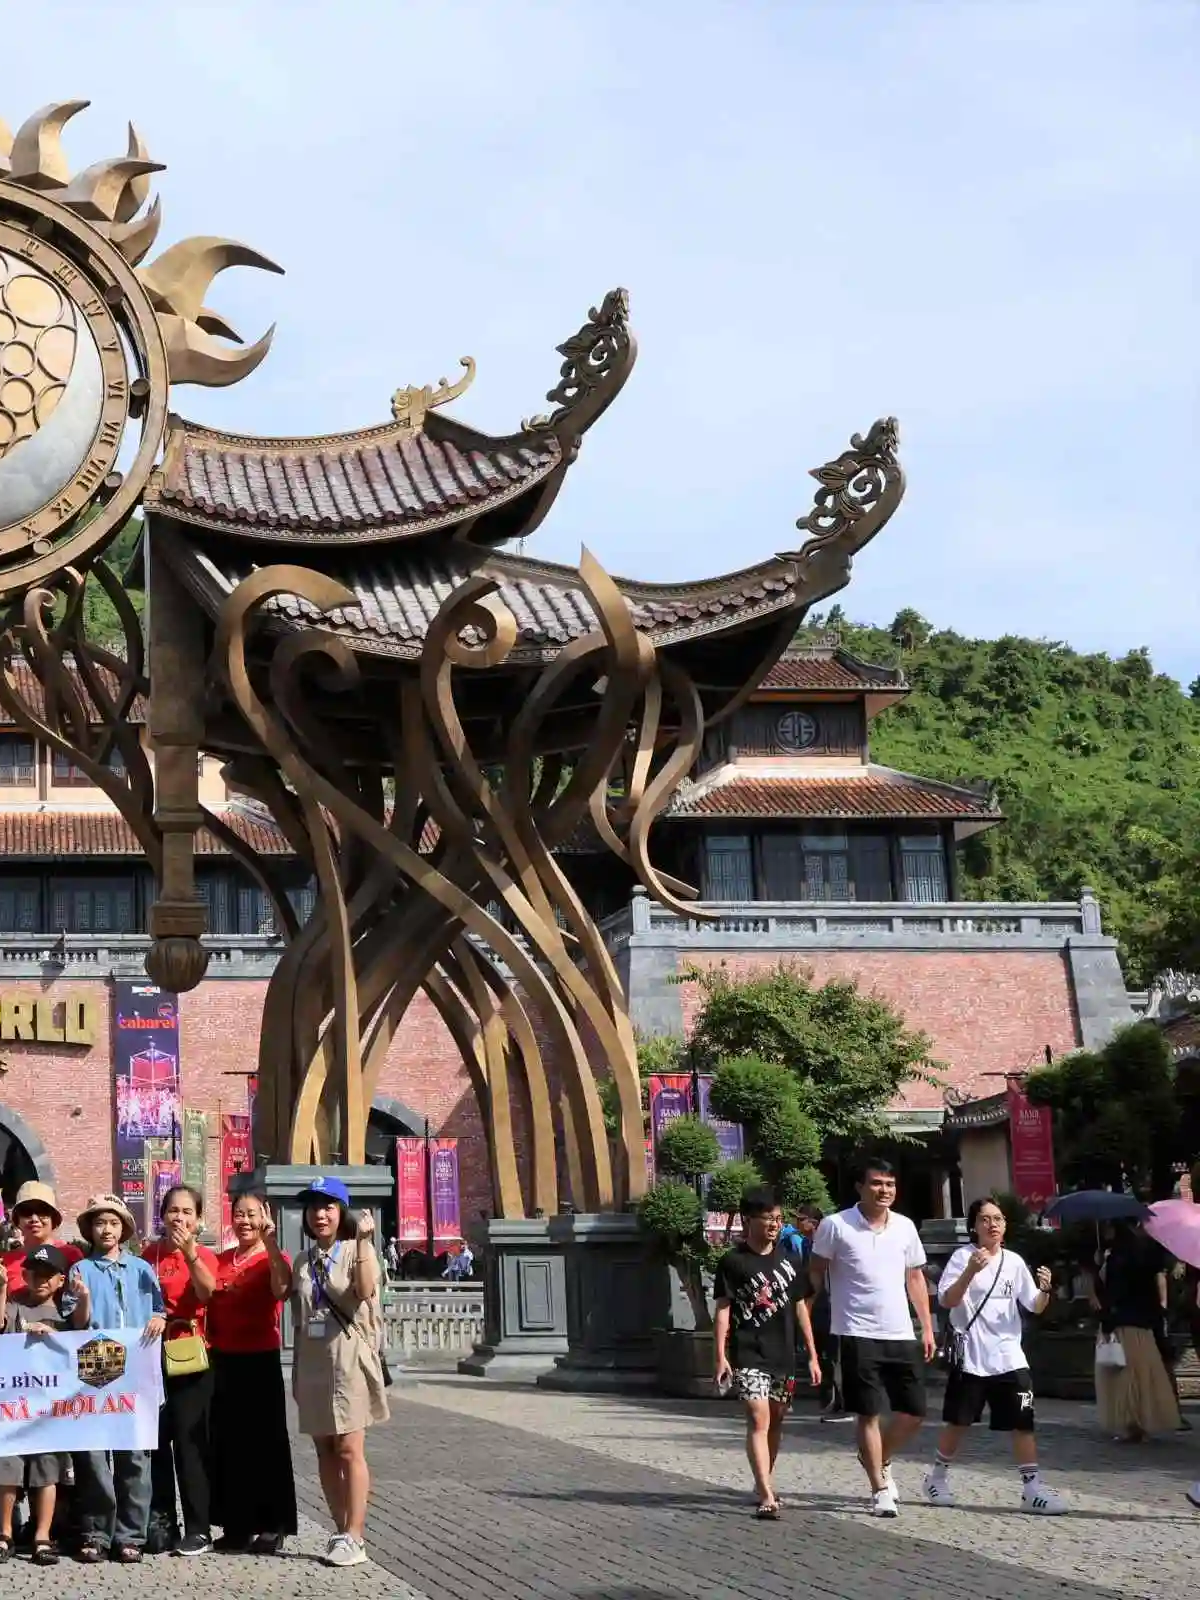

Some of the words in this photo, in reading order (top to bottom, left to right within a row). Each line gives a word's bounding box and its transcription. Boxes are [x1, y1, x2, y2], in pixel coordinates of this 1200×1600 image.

[119, 1016, 175, 1029] cabaret
[11, 1371, 59, 1389] BÌNH
[52, 1392, 96, 1420] HỘI
[98, 1392, 137, 1414] AN
